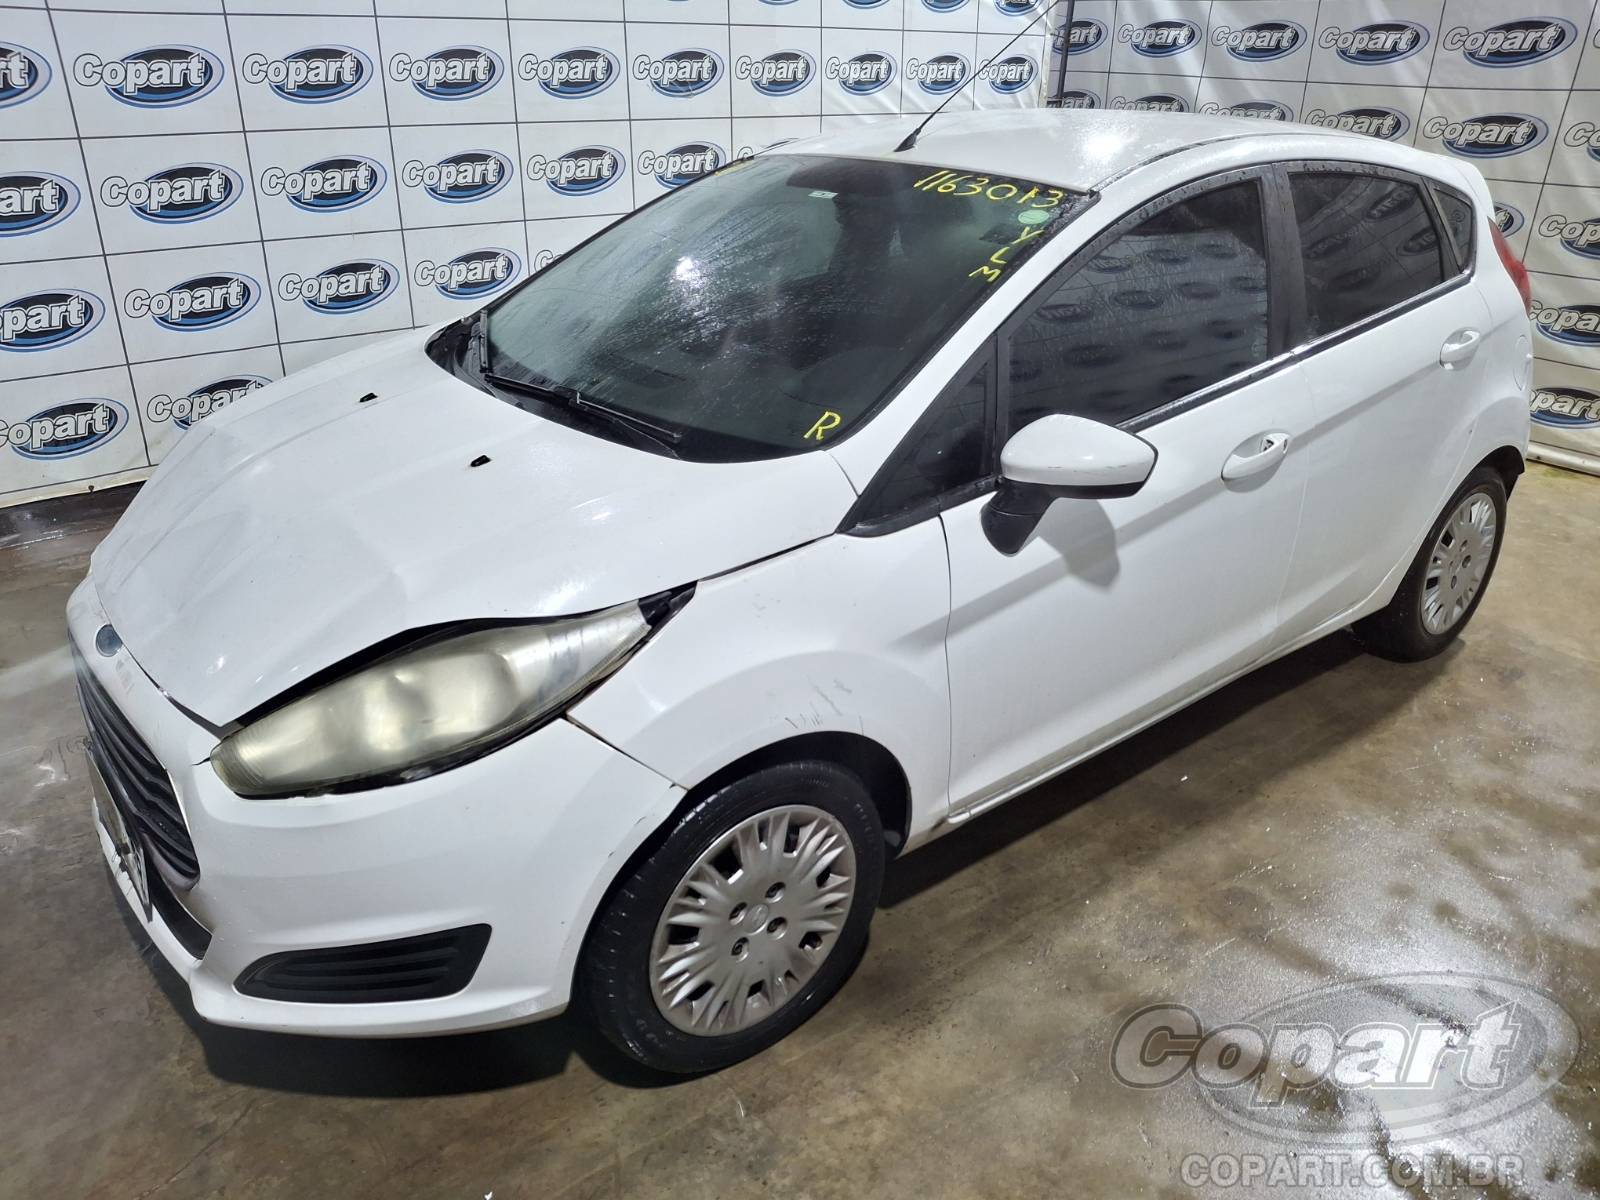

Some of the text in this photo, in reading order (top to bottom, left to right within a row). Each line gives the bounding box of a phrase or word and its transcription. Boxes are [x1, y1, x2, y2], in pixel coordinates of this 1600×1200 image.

[1118, 24, 1194, 47] Copart
[1211, 25, 1296, 51] Copart
[1319, 26, 1417, 55] Copart
[1443, 23, 1563, 57] Copart
[73, 51, 207, 96] Copart
[243, 52, 358, 91] Copart
[389, 52, 489, 88] Copart
[518, 53, 608, 88] Copart
[632, 54, 715, 85] Copart
[735, 55, 807, 85] Copart
[825, 56, 891, 85] Copart
[905, 57, 963, 84] Copart
[978, 58, 1033, 83] Copart
[1423, 116, 1532, 147] Copart
[402, 152, 500, 193] Copart
[527, 152, 613, 186] Copart
[637, 147, 715, 180] Copart
[0, 179, 60, 216] art
[101, 169, 224, 213] Copart
[261, 162, 371, 201] Copart
[1538, 214, 1600, 247] Cop
[278, 264, 385, 304] Copart
[414, 254, 508, 291] Copart
[124, 278, 244, 321] Copart
[0, 295, 85, 342] part
[1530, 390, 1600, 420] part
[803, 411, 841, 441] R
